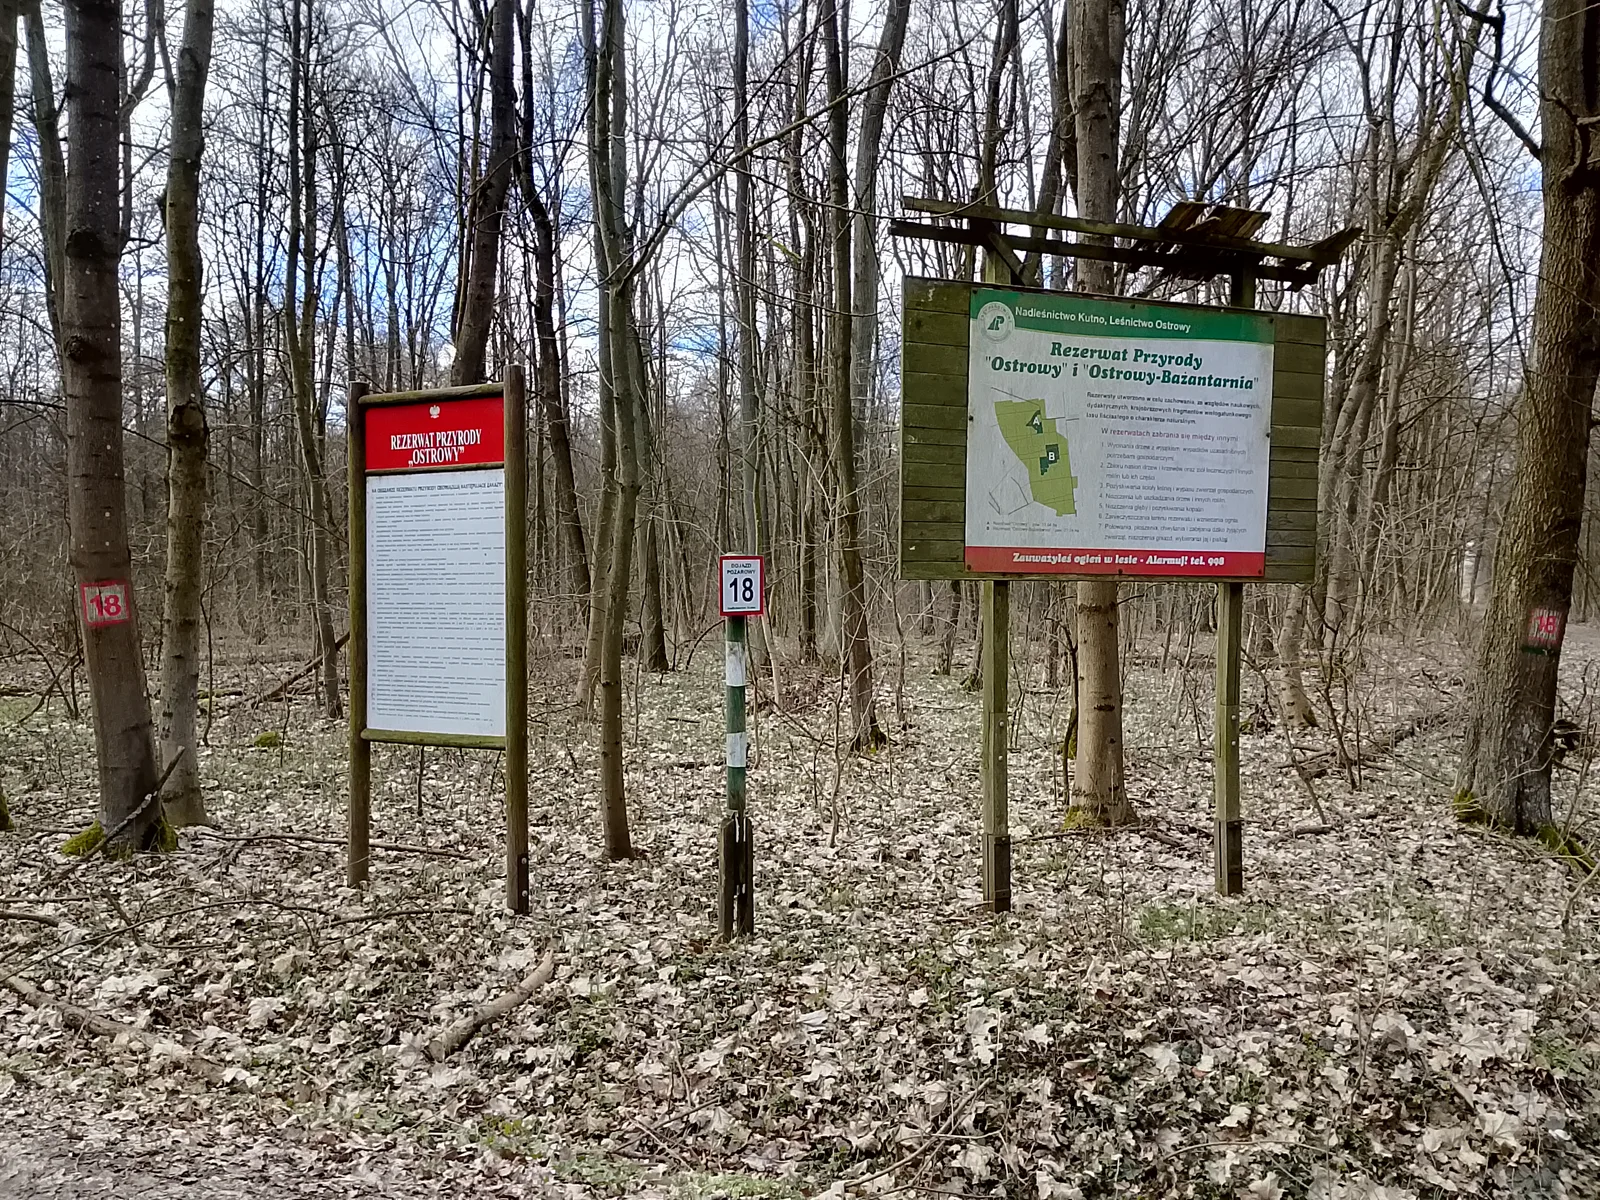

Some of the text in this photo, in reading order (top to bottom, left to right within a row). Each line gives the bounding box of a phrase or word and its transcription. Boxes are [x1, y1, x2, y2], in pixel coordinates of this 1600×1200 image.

[1015, 306, 1076, 321] Nadleśnictwo
[1078, 312, 1108, 326] Kutno,
[1109, 315, 1154, 329] Leśnictwo
[1155, 319, 1192, 334] Ostrowy
[1050, 341, 1203, 371] Rezerwat Przyrody
[985, 356, 1259, 390] "Ostrowy" i "Ostrowy-Bażantarnia"
[1033, 416, 1040, 425] A
[390, 429, 482, 451] REZERWAT PRZYRODY
[1110, 429, 1151, 437] rezerwatach
[1151, 431, 1180, 439] zabrania
[1191, 434, 1215, 442] między
[408, 446, 465, 468] „OSTROWY”
[1049, 452, 1055, 461] B
[1074, 553, 1102, 566] ogień
[1103, 556, 1113, 564] w
[1114, 554, 1138, 565] lesie
[1145, 555, 1189, 567] Alarmuj!
[1190, 556, 1206, 566] tel.
[1207, 557, 1225, 567] 998
[729, 577, 754, 603] 18
[89, 594, 122, 617] 18
[1535, 615, 1557, 635] 18
